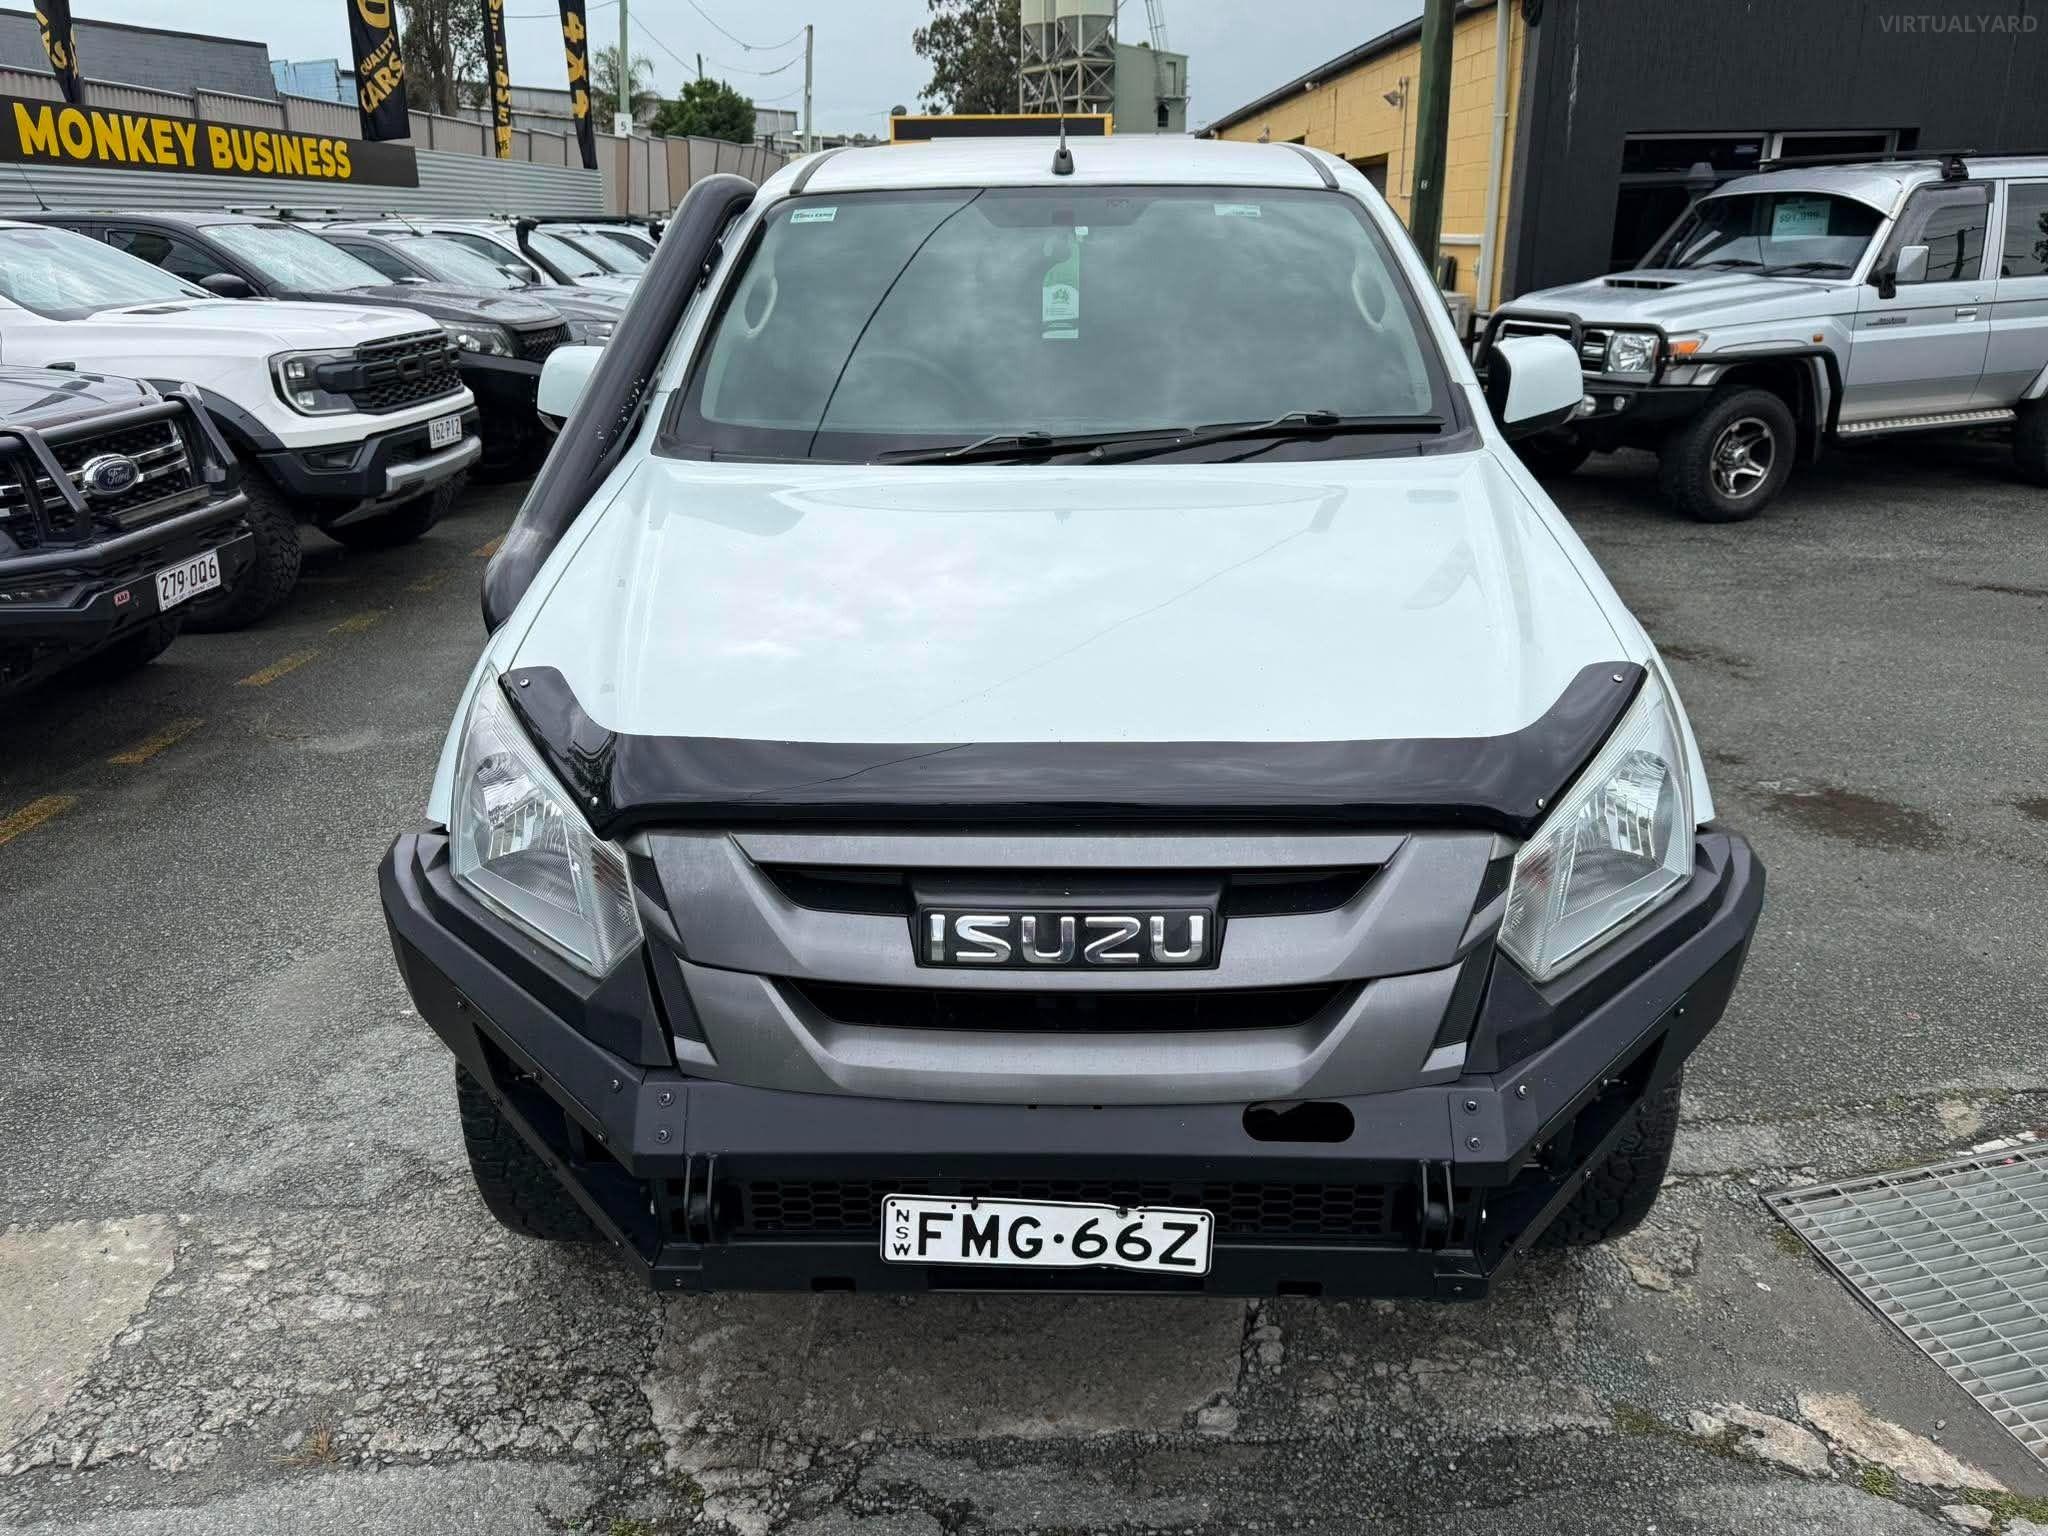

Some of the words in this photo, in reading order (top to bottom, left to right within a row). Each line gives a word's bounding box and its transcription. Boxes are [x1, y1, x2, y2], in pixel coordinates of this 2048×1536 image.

[360, 29, 395, 75] QUALITY
[361, 51, 404, 113] CARS
[12, 102, 198, 167] MONKEY
[207, 125, 352, 179] BUSINESS
[106, 466, 131, 485] Ford
[929, 914, 1205, 964] ISUZU
[894, 1208, 912, 1256] NSW
